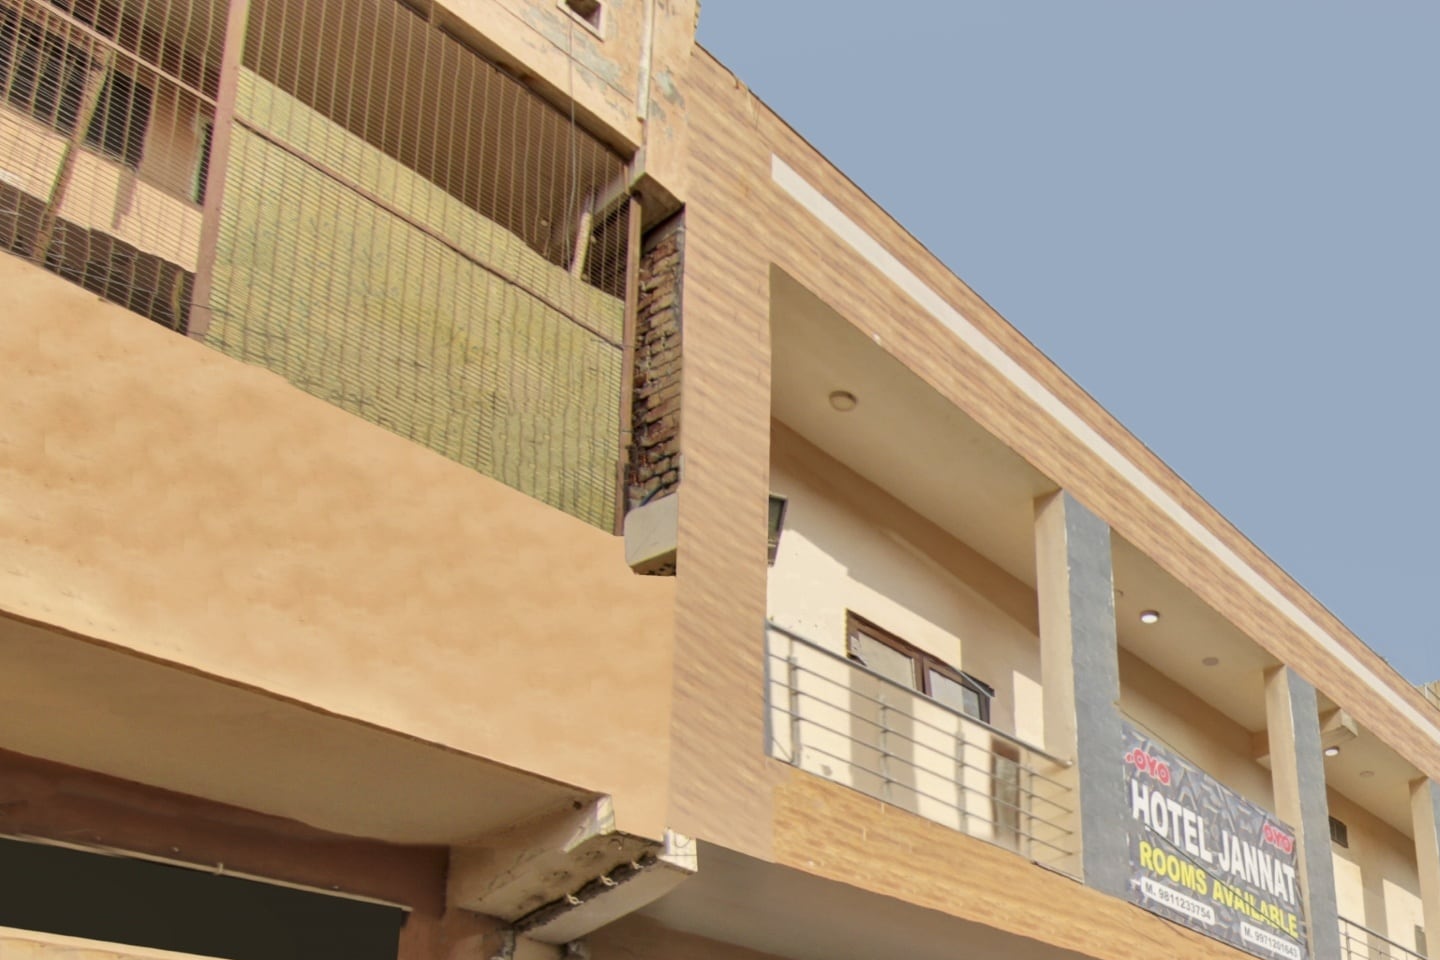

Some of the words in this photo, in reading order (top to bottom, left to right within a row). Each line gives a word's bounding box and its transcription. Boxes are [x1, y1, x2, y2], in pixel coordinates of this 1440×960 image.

[1134, 749, 1171, 785] OYO
[1131, 779, 1213, 864] HOTEL
[1219, 830, 1296, 905] JANNAT
[1263, 822, 1295, 854] OYO
[1139, 841, 1208, 896] ROOMS
[1212, 881, 1299, 939] AVAILABLE
